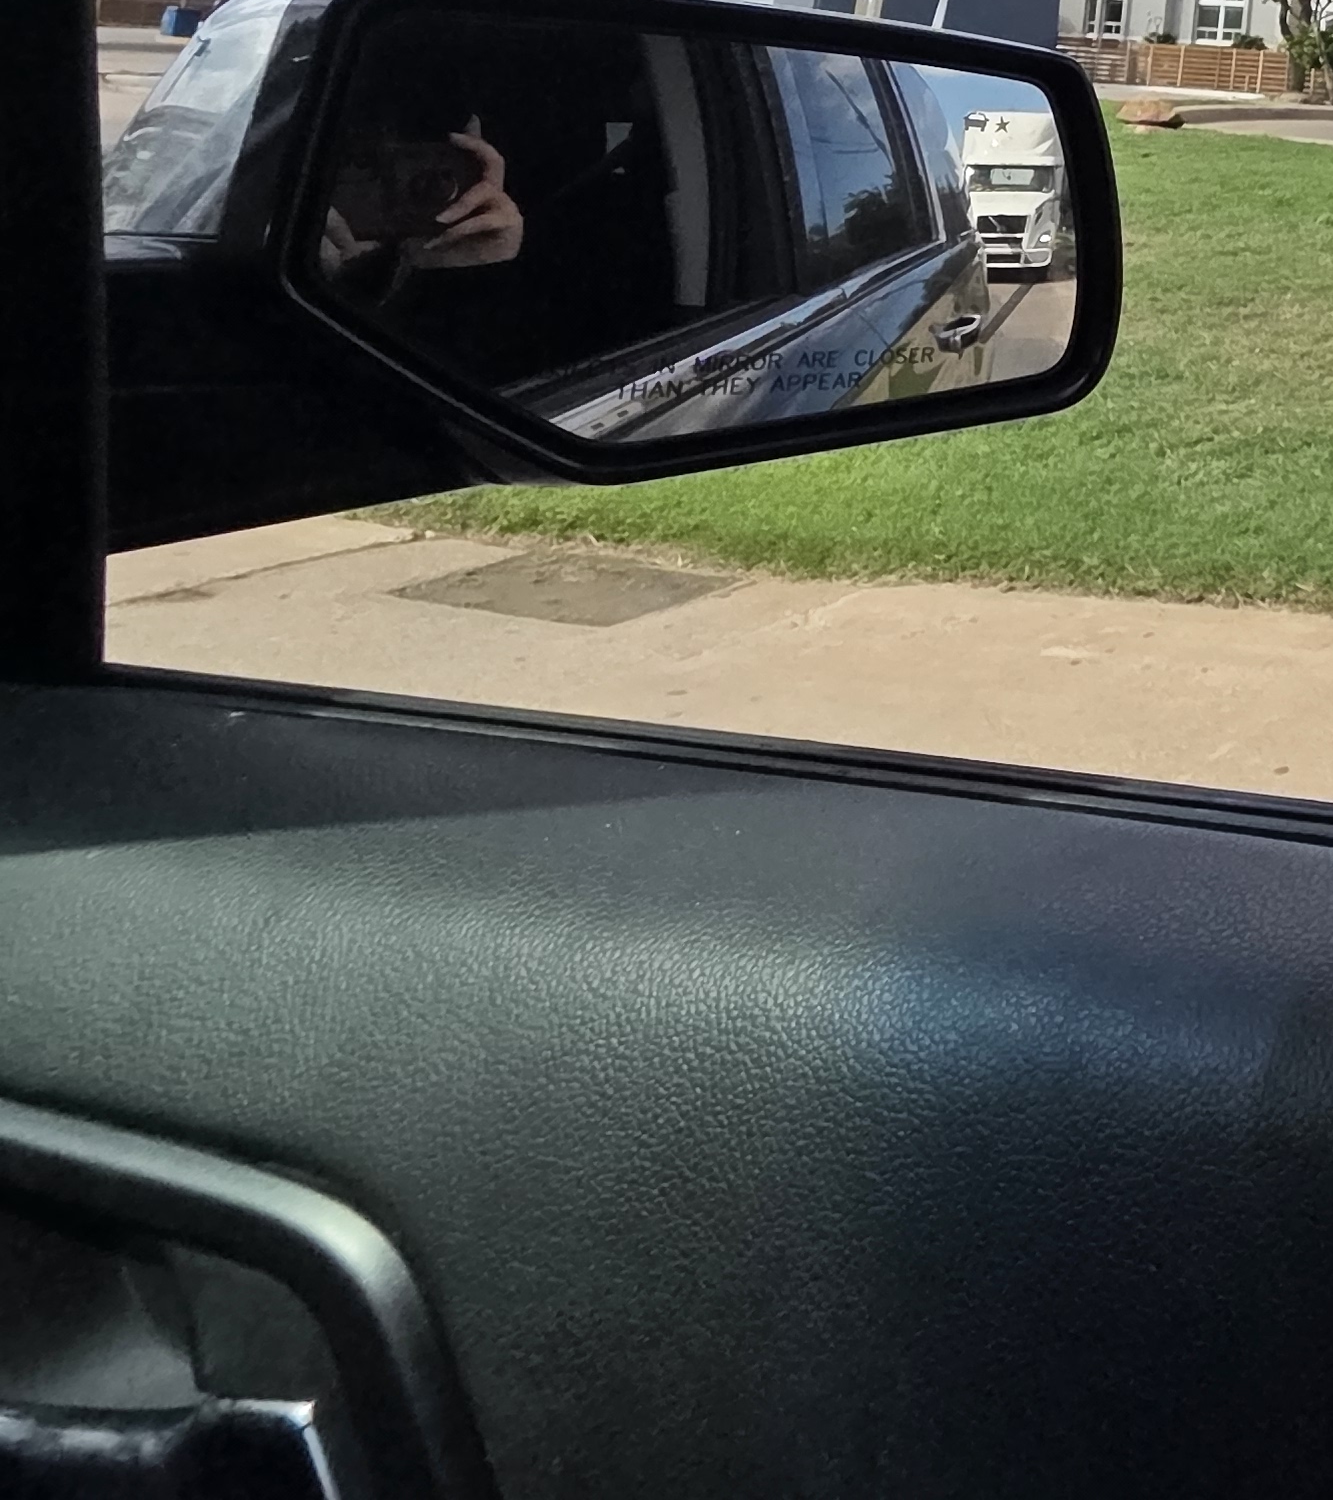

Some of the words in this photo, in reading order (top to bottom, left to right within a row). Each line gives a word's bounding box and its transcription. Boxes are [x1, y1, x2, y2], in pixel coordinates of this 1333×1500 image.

[694, 352, 784, 374] MIRROR
[797, 350, 838, 369] ARE
[855, 346, 936, 367] CLOSER
[617, 380, 684, 401] THAN
[700, 376, 762, 397] THEY
[769, 371, 863, 393] APPEAR
